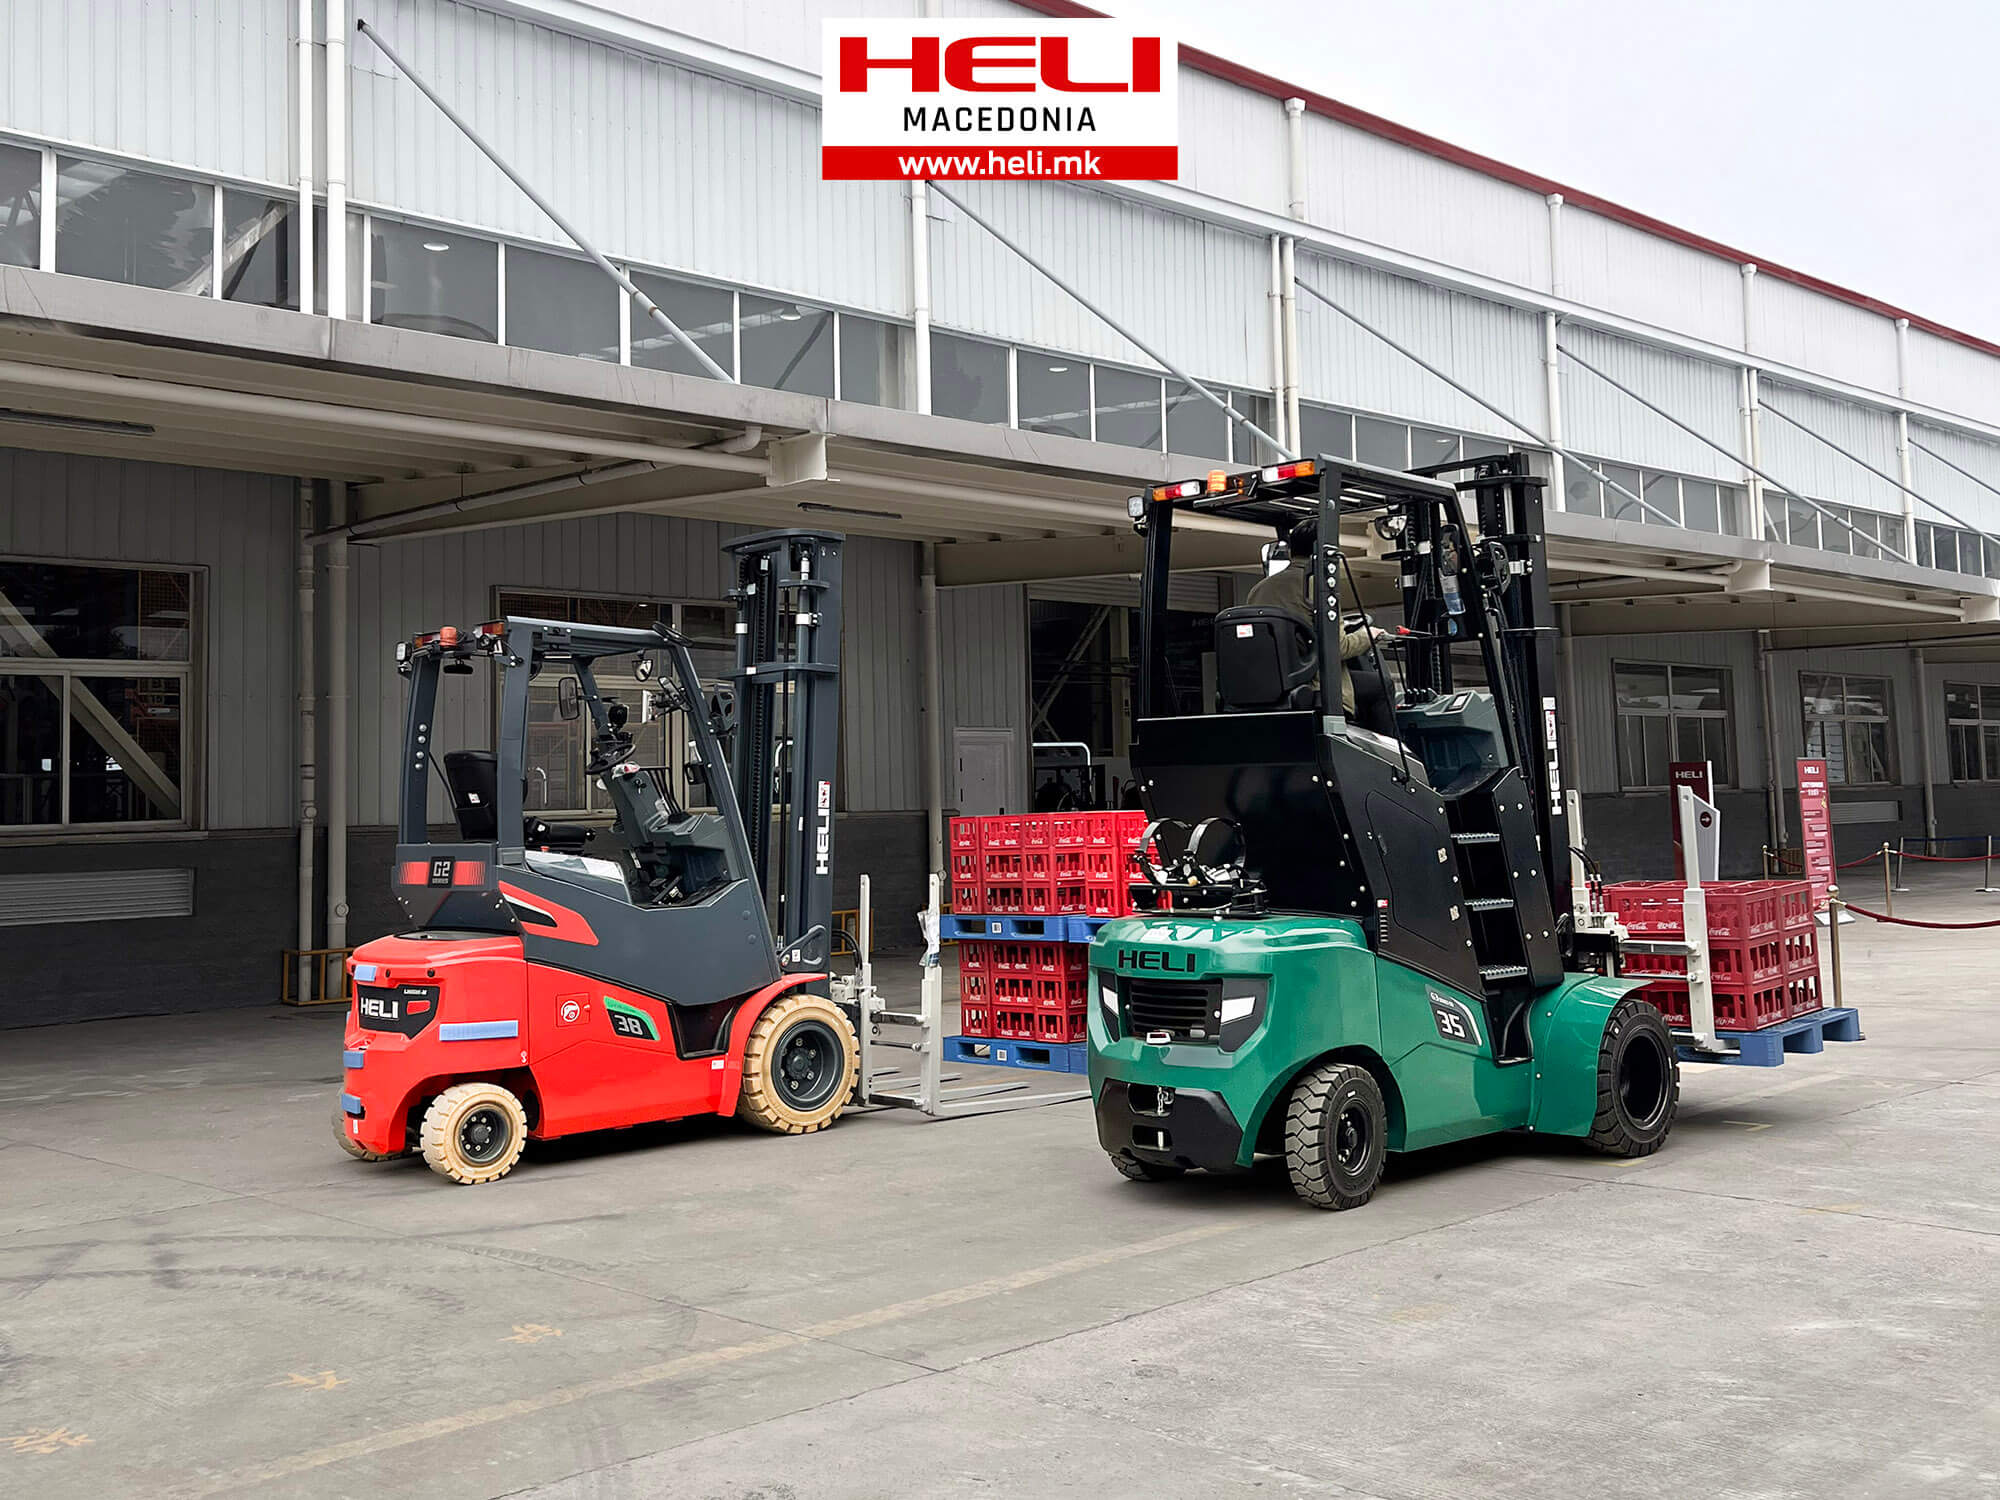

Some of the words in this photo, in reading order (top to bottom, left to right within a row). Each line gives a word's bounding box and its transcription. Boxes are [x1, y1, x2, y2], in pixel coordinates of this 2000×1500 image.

[1547, 741, 1562, 815] HELI
[1675, 770, 1704, 779] HELI
[816, 809, 829, 874] HELI
[433, 861, 451, 877] G2
[1118, 949, 1196, 973] HELI
[360, 998, 399, 1019] HELI
[614, 1014, 643, 1036] 38
[1436, 1010, 1466, 1038] 35
